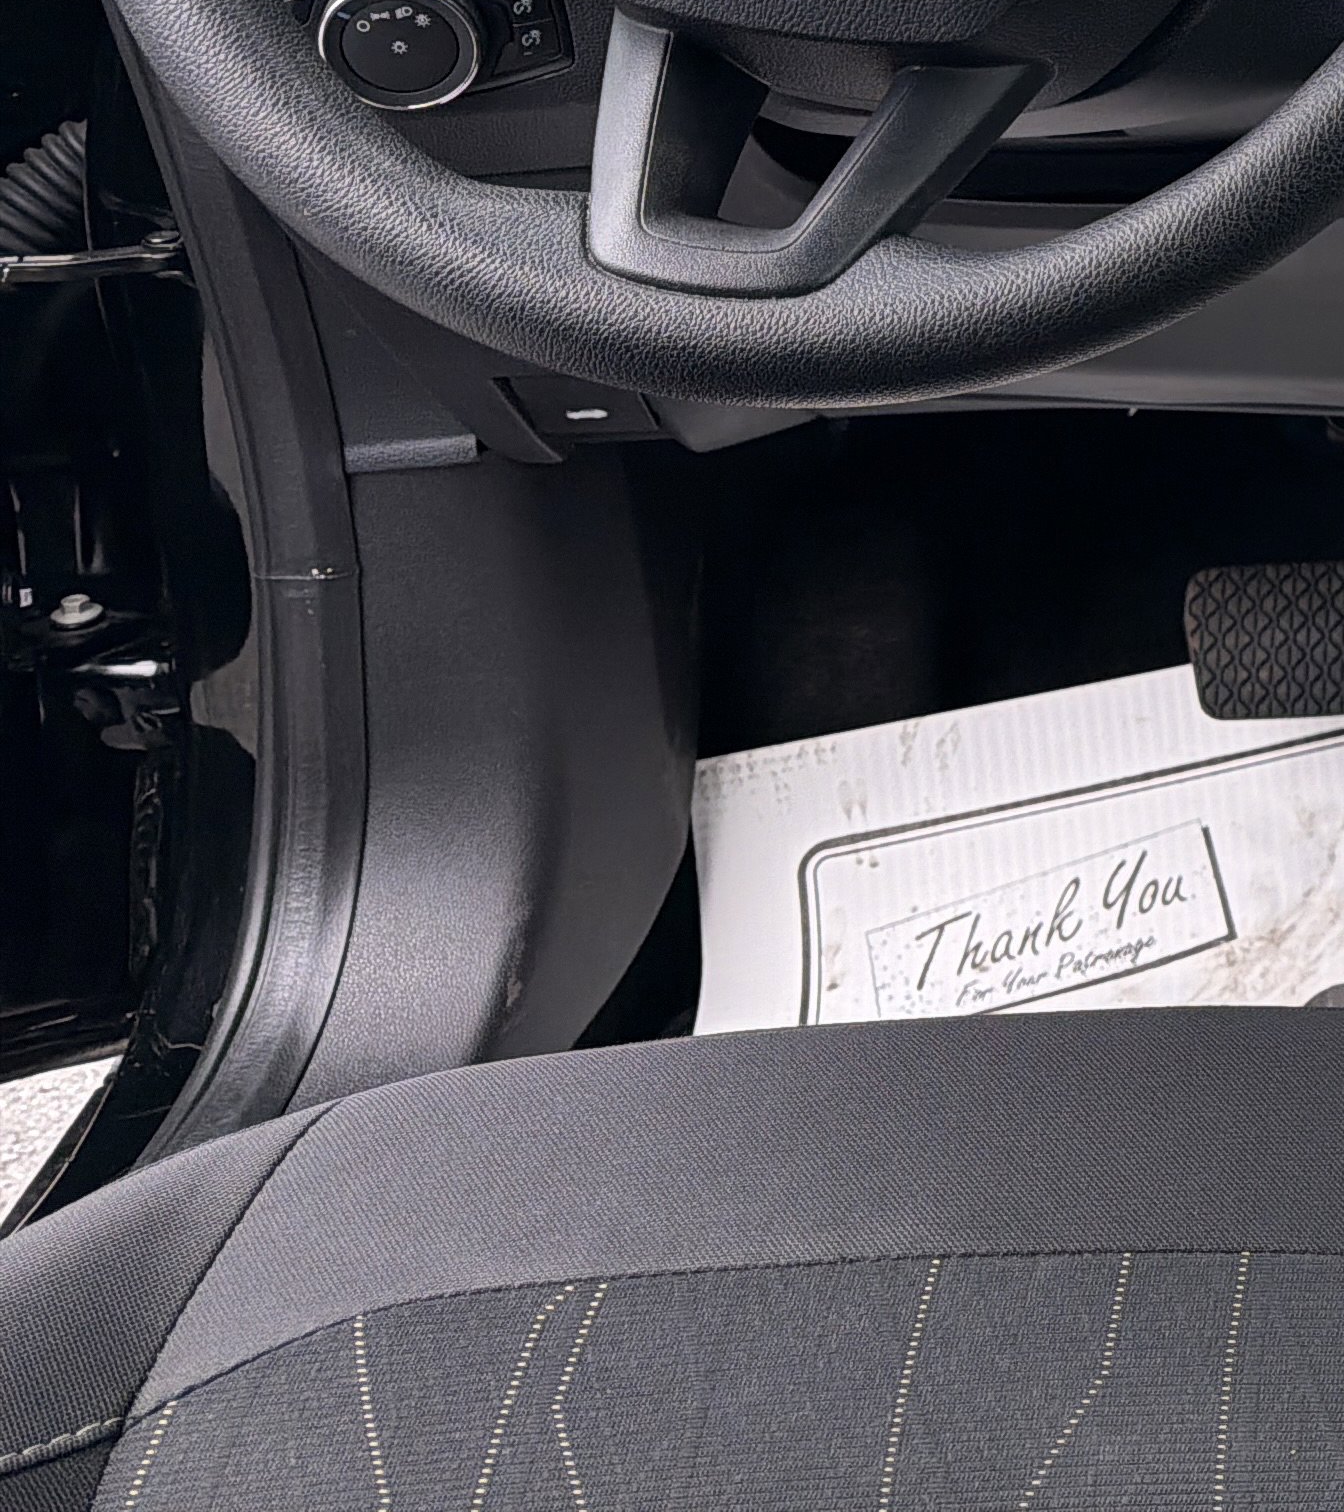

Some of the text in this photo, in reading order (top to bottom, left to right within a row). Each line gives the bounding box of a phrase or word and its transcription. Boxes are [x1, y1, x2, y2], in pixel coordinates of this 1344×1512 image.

[915, 849, 1191, 991] Thank You
[956, 933, 1158, 1005] For Your Patronage
